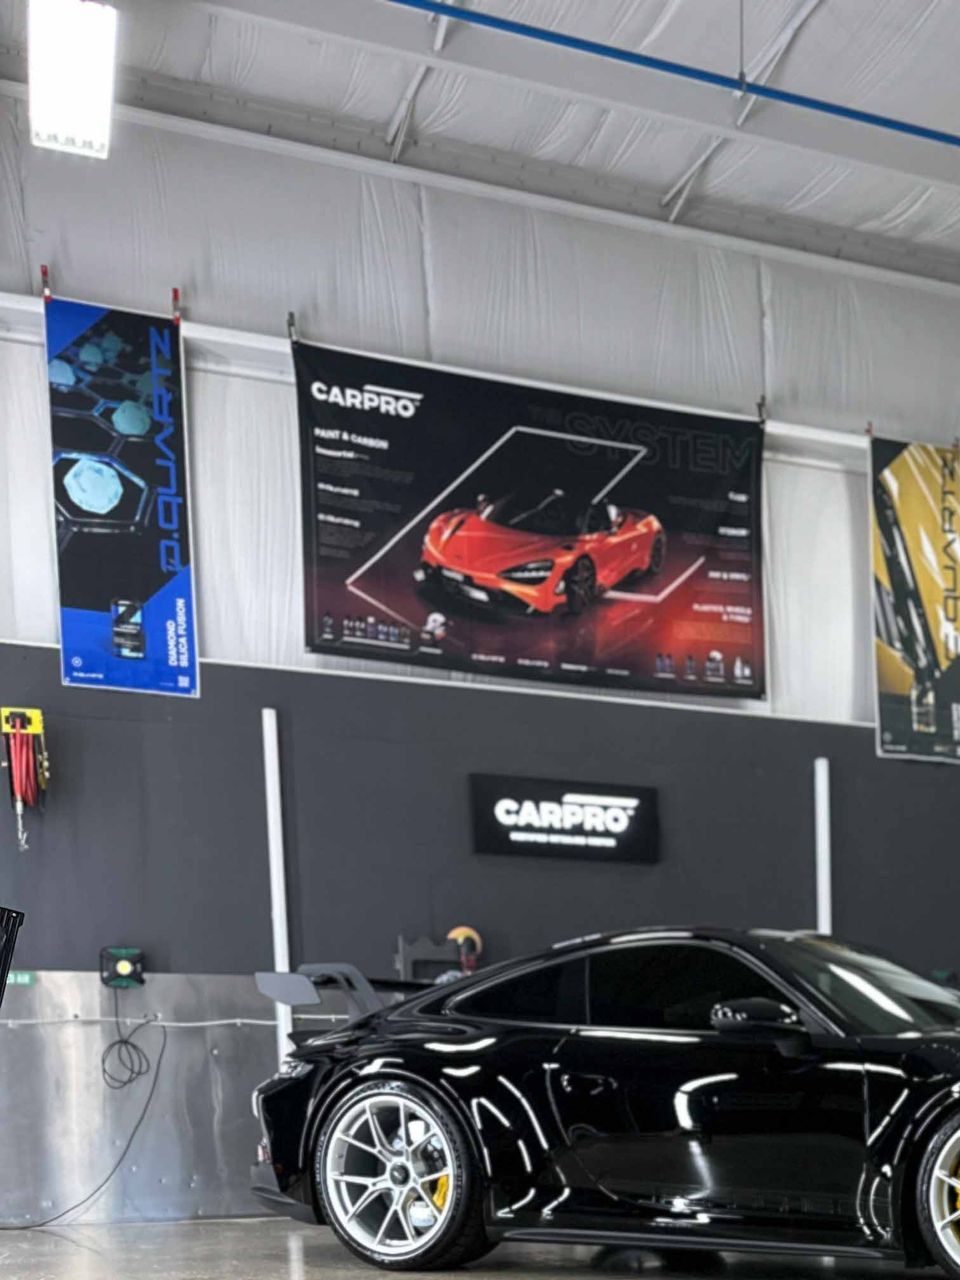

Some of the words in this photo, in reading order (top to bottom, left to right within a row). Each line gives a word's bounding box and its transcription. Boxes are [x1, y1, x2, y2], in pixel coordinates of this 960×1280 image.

[310, 381, 424, 418] CARPRO
[565, 411, 758, 475] SYSTEM
[176, 598, 187, 635] FUSION
[166, 619, 178, 666] DIAMOND
[494, 793, 640, 833] CARPRO
